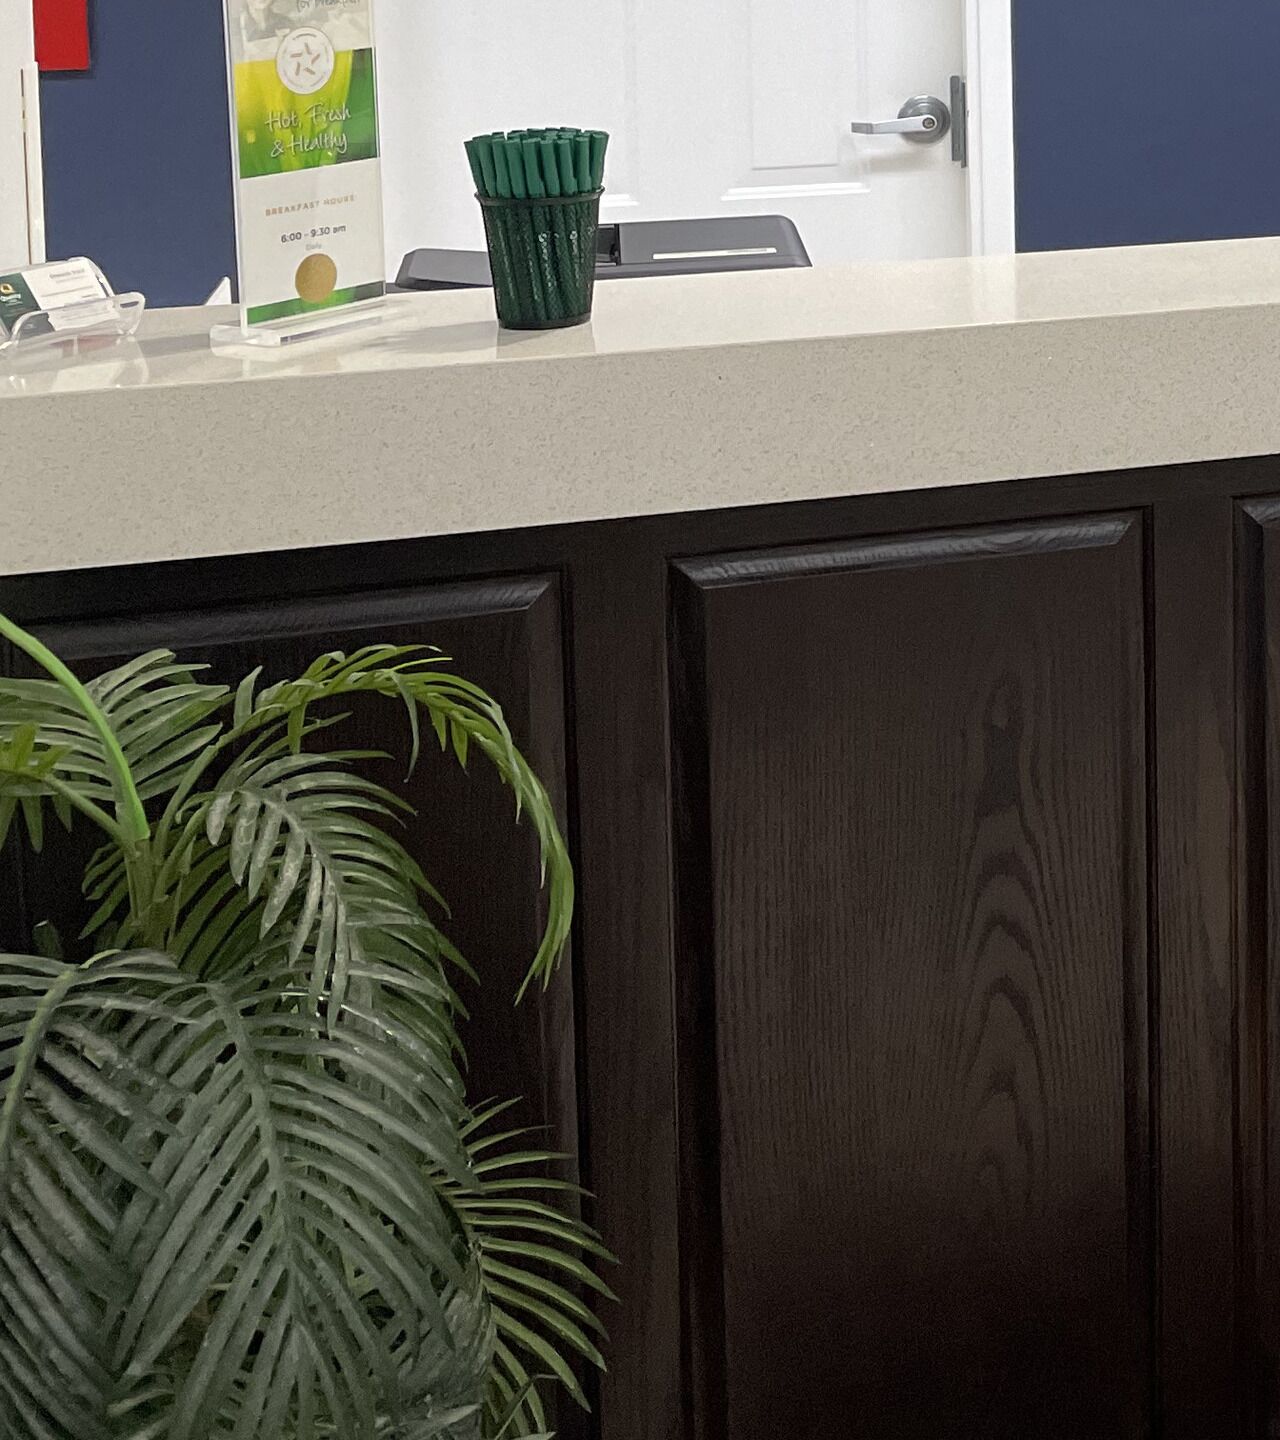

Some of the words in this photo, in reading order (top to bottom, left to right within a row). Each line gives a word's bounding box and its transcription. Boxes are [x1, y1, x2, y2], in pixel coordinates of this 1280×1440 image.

[265, 111, 302, 133] Hot,
[304, 102, 351, 124] Fresh
[270, 140, 285, 157] &
[287, 130, 348, 156] Healthy
[265, 201, 320, 216] BREAKFAST
[280, 232, 302, 243] 6:00
[310, 227, 330, 238] 9:30
[333, 225, 347, 234] am
